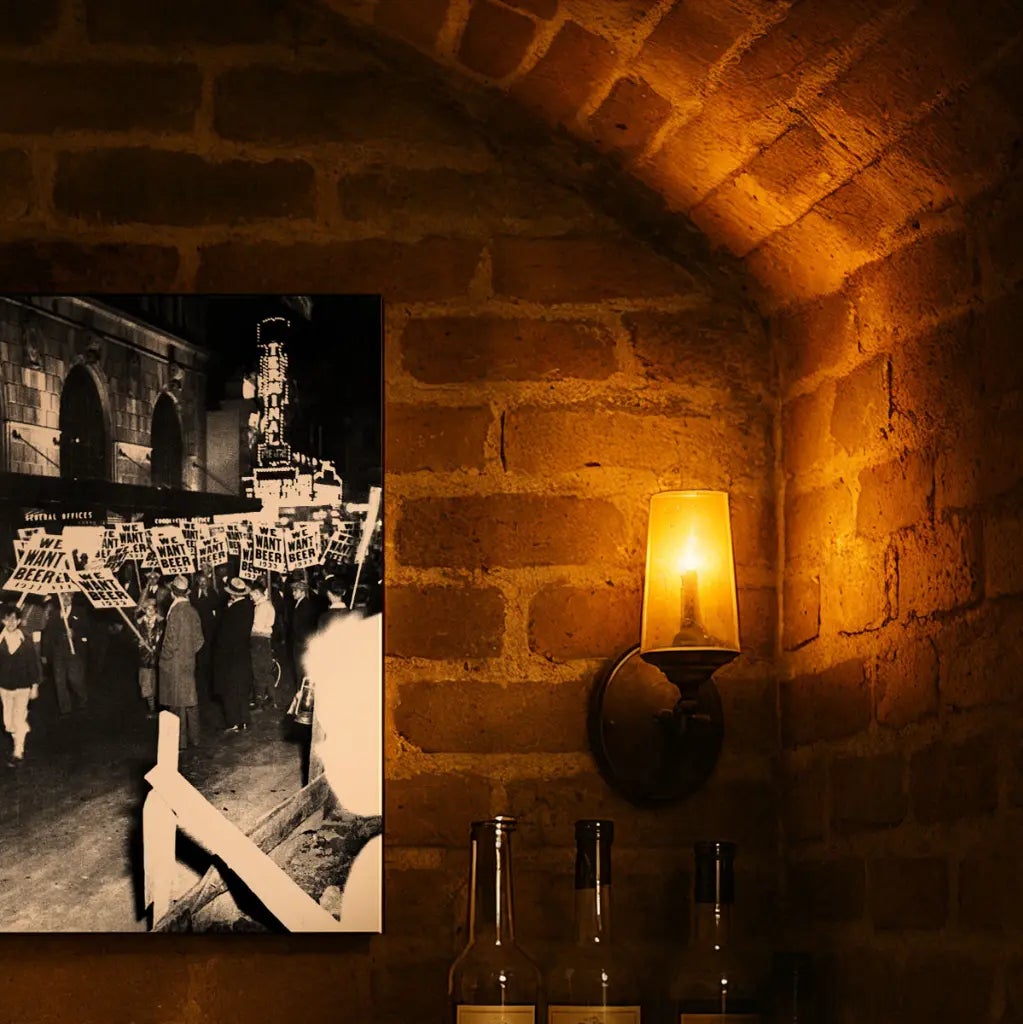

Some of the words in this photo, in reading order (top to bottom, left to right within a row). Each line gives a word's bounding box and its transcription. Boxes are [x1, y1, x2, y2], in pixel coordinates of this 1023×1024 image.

[61, 511, 93, 520] OFFICES
[259, 526, 277, 537] WE
[292, 529, 308, 539] WE
[40, 538, 63, 549] WE
[119, 532, 143, 544] WANT
[159, 537, 178, 545] WE
[255, 535, 282, 551] WANT
[288, 536, 314, 552] WANT
[157, 544, 186, 558] WANT
[199, 542, 224, 556] WANT
[23, 549, 66, 569] WANT
[255, 548, 282, 563] BEER
[289, 548, 316, 563] BEER
[160, 556, 191, 568] BEER
[13, 567, 56, 584] BEER
[79, 572, 105, 580] WE
[78, 579, 118, 591] WANT
[87, 591, 128, 601] BEER
